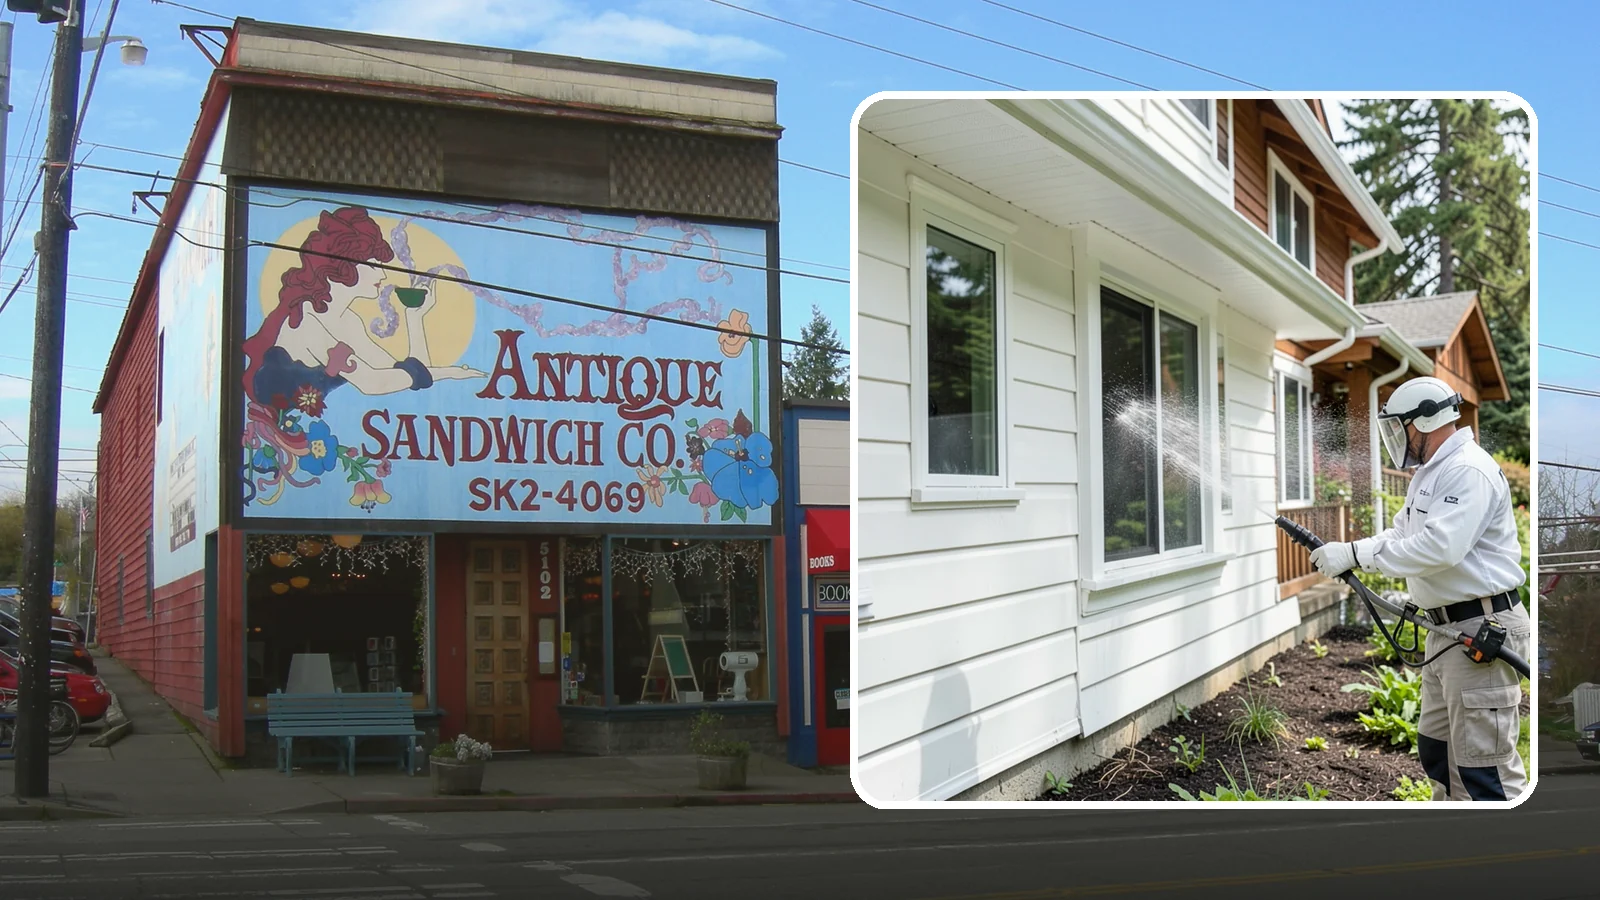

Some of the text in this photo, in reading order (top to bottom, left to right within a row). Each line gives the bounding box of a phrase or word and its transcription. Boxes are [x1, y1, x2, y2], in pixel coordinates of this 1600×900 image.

[476, 328, 723, 420] ANTIQUE
[361, 408, 685, 469] SANDWICH CO.
[468, 477, 646, 513] SK2-4069
[539, 541, 552, 600] 5102
[809, 555, 835, 569] BOOKS
